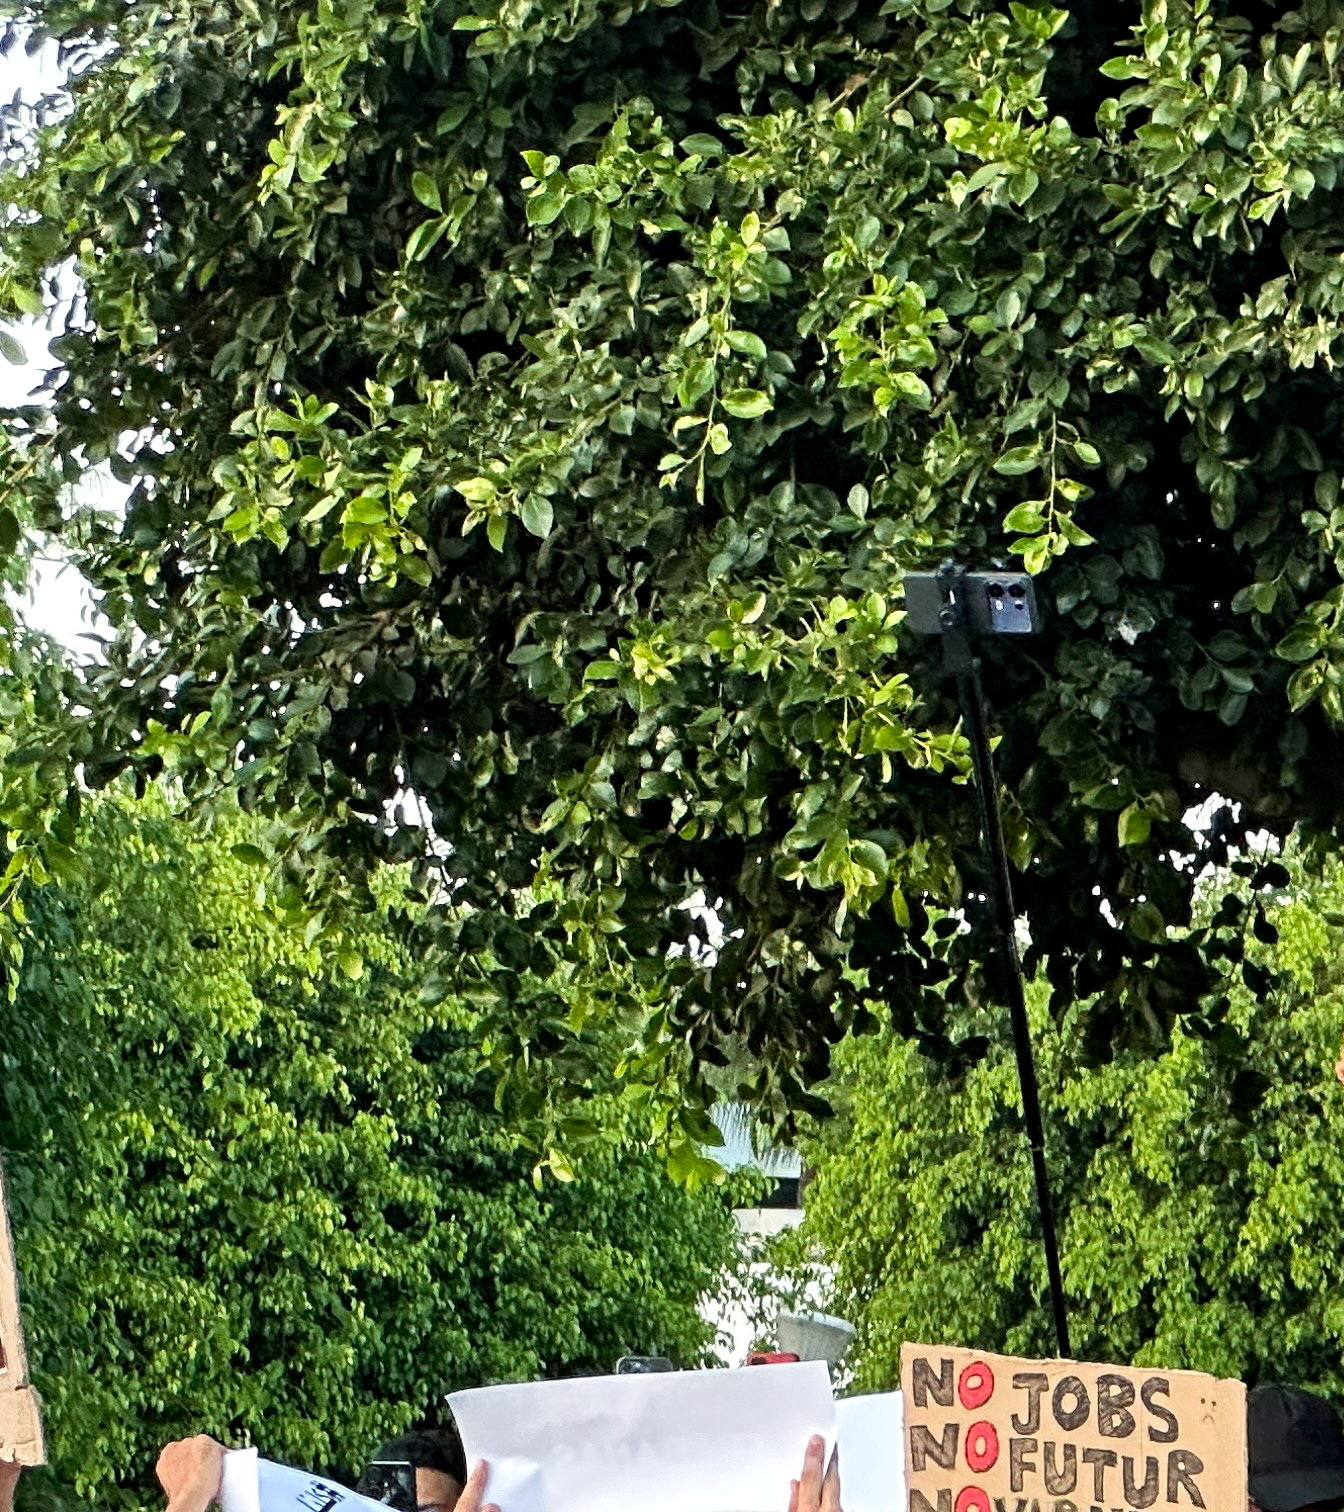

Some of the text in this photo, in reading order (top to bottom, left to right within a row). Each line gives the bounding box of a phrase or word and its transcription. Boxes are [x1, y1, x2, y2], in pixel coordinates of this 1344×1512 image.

[912, 1357, 1180, 1443] NO JOBS
[909, 1420, 1207, 1509] NO FUTUR
